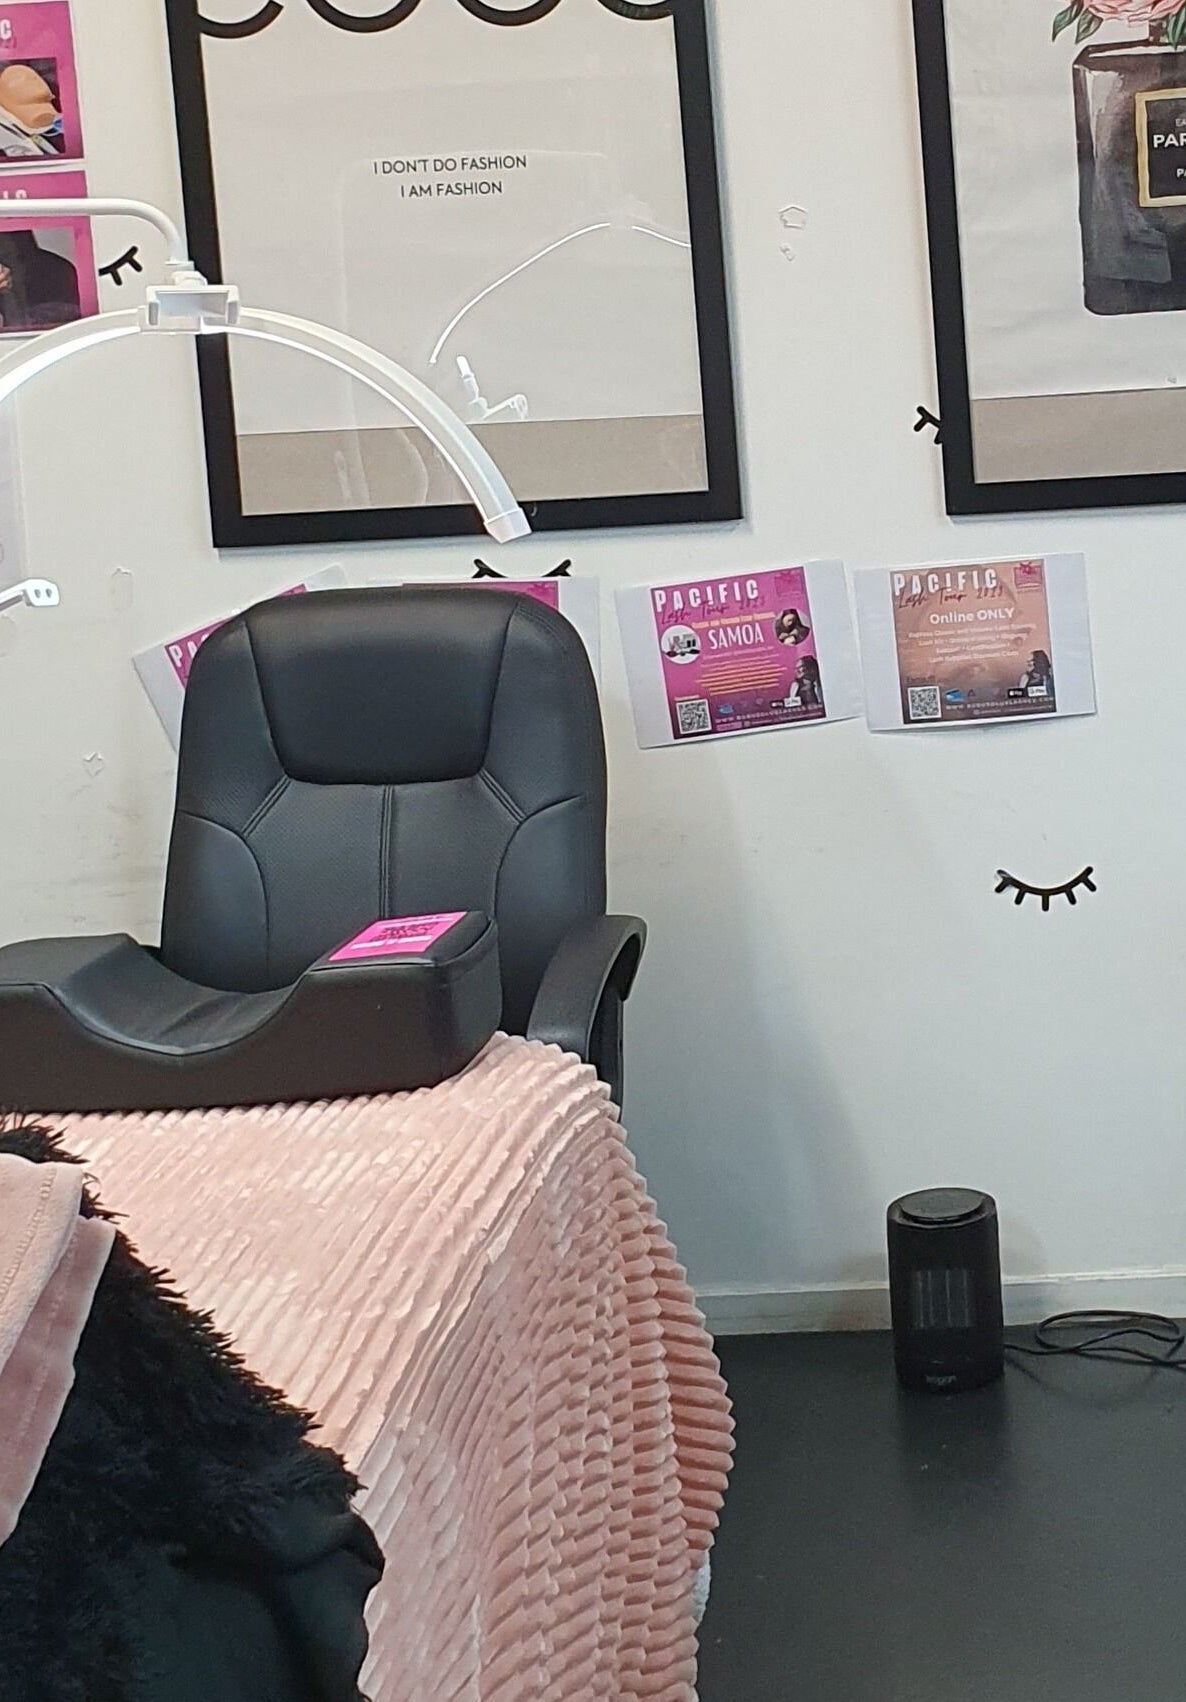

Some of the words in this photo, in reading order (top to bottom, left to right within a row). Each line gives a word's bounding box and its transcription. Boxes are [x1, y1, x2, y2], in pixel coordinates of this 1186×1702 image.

[374, 162, 378, 174] I
[382, 159, 429, 174] DON'T
[433, 158, 457, 172] DO
[461, 154, 527, 171] FASHION
[401, 185, 405, 198] I
[408, 184, 433, 198] AM
[436, 181, 502, 197] FASHION
[893, 568, 997, 596] PACIFIC
[654, 579, 759, 612] PACIFIC
[929, 611, 975, 625] Online
[976, 607, 1015, 620] ONLY
[708, 622, 765, 651] SAMOA
